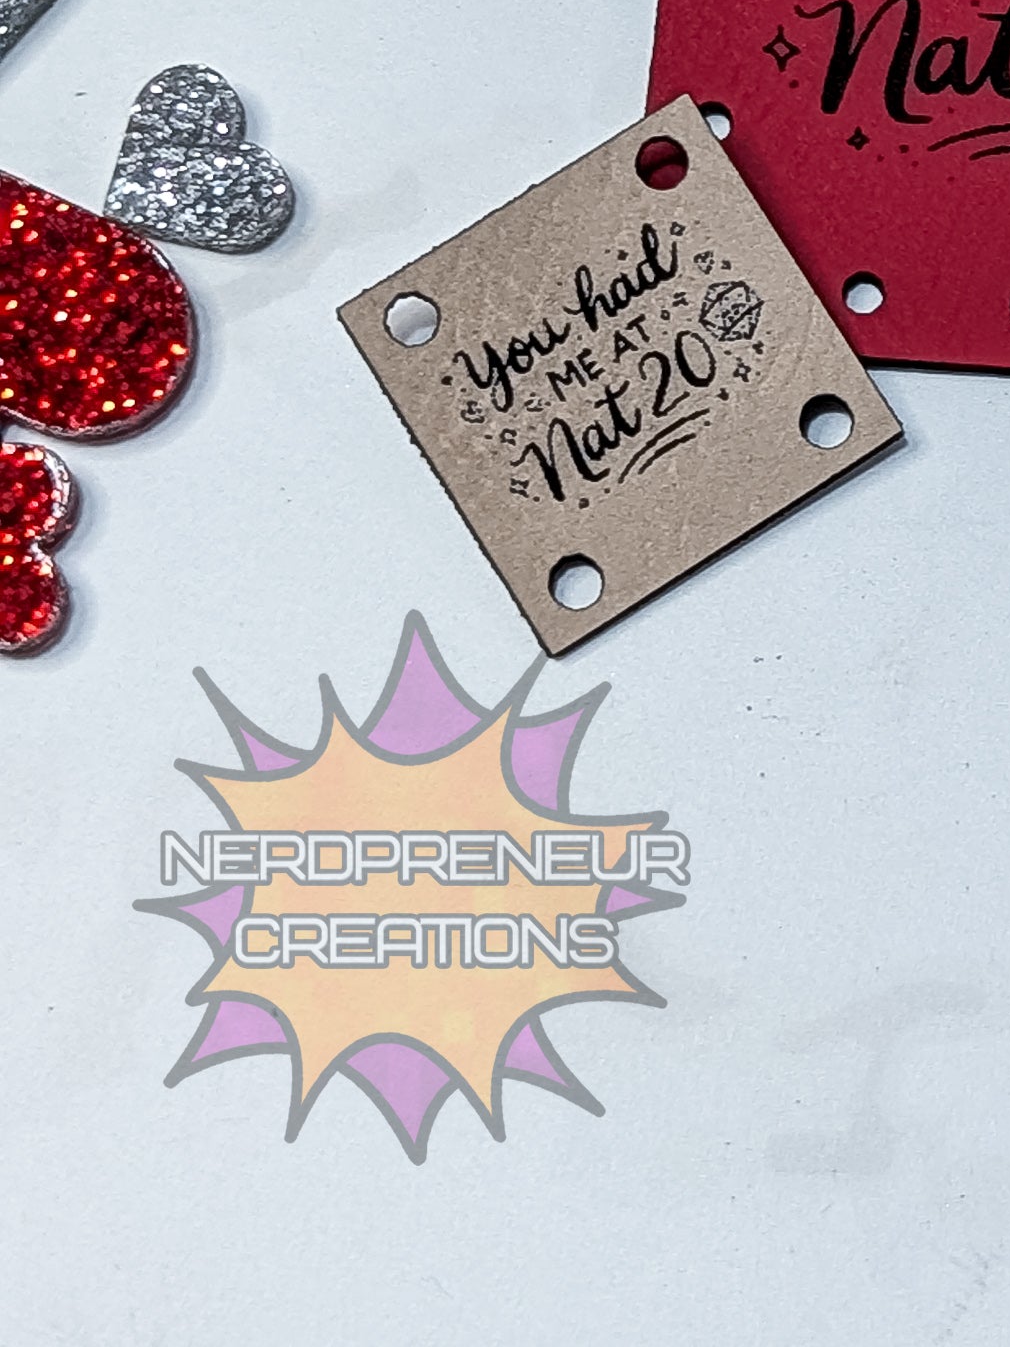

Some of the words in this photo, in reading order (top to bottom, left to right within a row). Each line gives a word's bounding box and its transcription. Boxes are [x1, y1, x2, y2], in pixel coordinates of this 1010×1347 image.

[452, 318, 571, 413] You
[564, 223, 679, 331] had
[547, 348, 605, 401] ME
[613, 314, 650, 363] AT
[510, 380, 642, 502] Nat
[639, 330, 717, 418] 20
